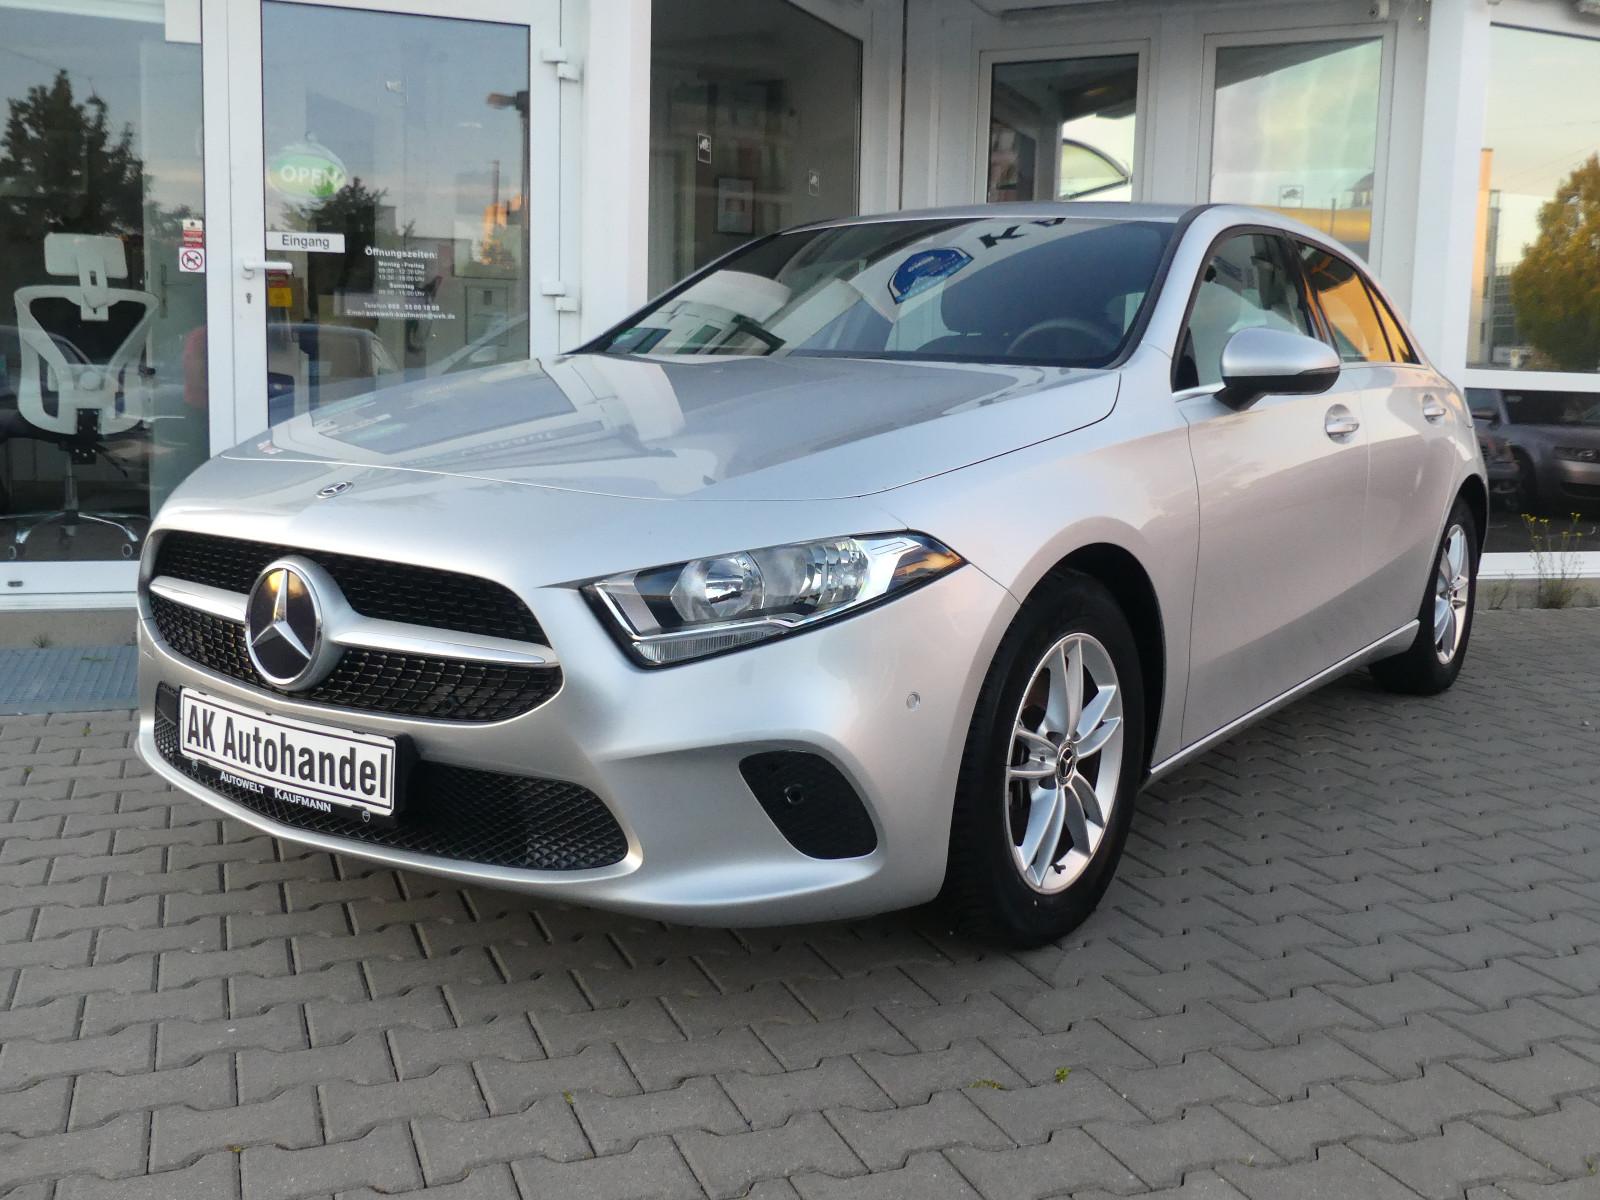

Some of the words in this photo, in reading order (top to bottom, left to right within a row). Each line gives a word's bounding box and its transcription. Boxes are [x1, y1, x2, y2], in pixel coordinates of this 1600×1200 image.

[281, 165, 338, 190] OPEN
[282, 234, 330, 250] Eingang
[365, 246, 438, 259] Öffnungszeiten:
[378, 260, 400, 268] Montag
[404, 262, 425, 270] Freitag
[389, 282, 415, 290] Samstag
[187, 704, 216, 753] AK
[223, 716, 388, 799] Autohandel
